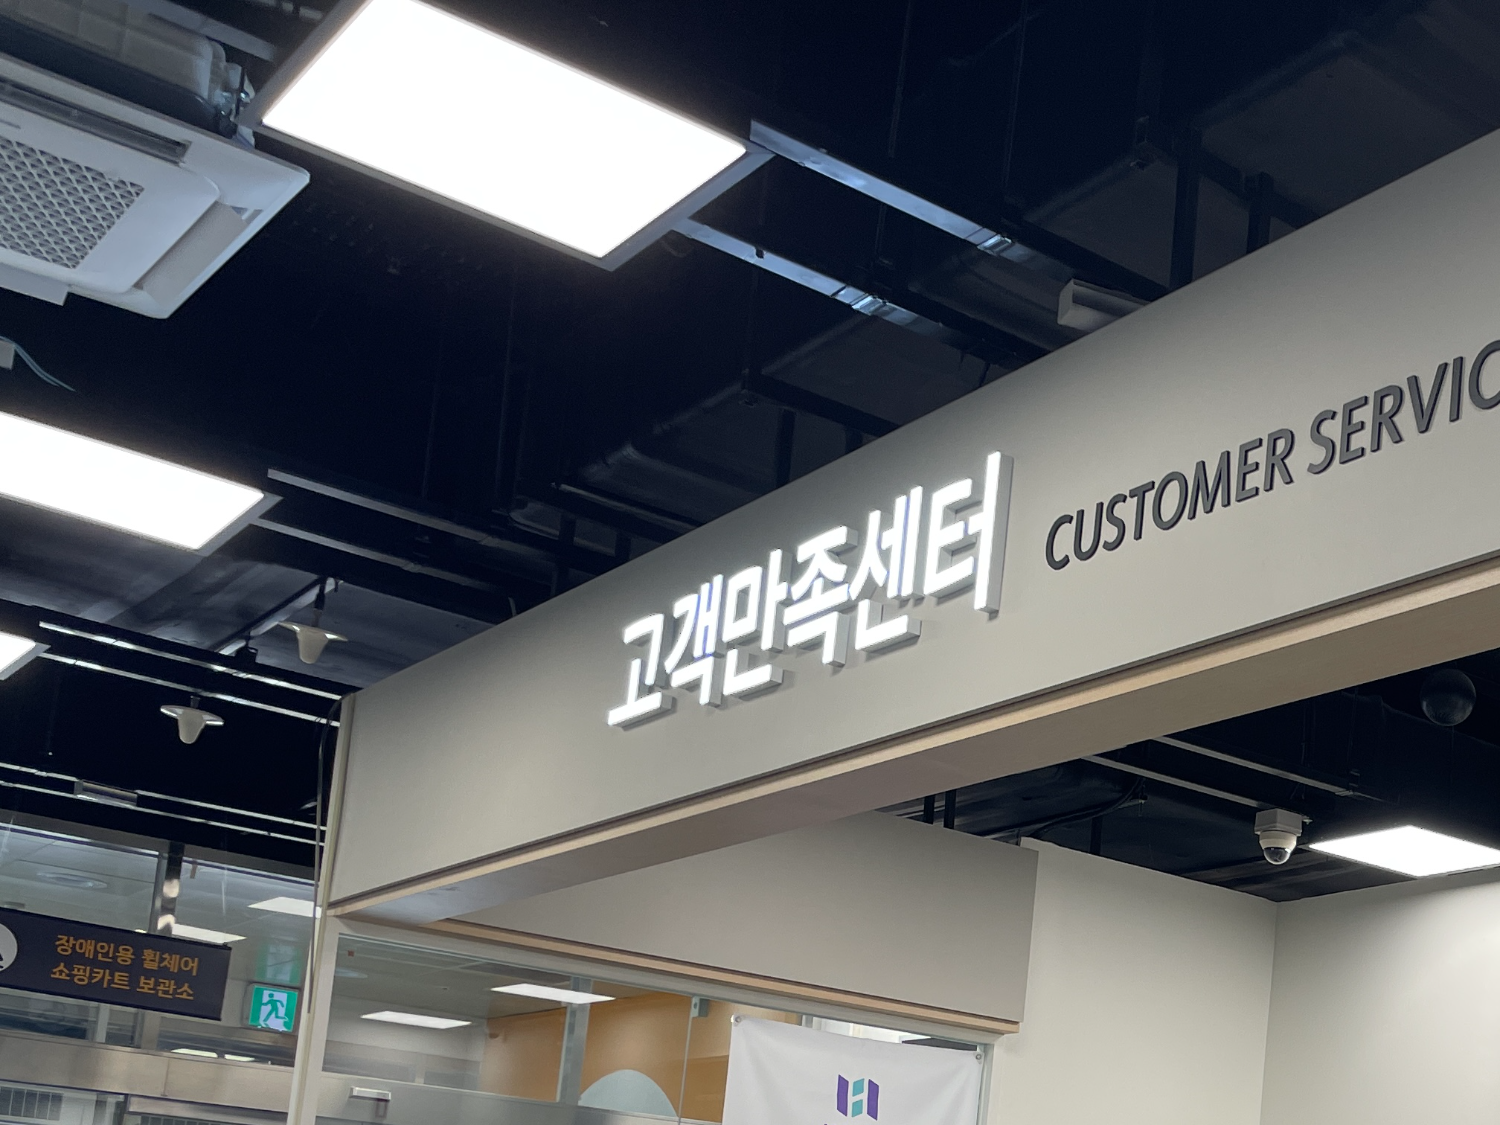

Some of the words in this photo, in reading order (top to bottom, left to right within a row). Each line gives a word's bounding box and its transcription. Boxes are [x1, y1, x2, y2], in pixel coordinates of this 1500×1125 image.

[1045, 427, 1296, 572] CUSTOMER
[607, 451, 1012, 727] 고객만족센터
[51, 962, 131, 990] 쇼핑카트
[137, 976, 194, 1000] 보관소
[54, 935, 135, 965] 장애인용
[141, 948, 199, 976] 휠체어
